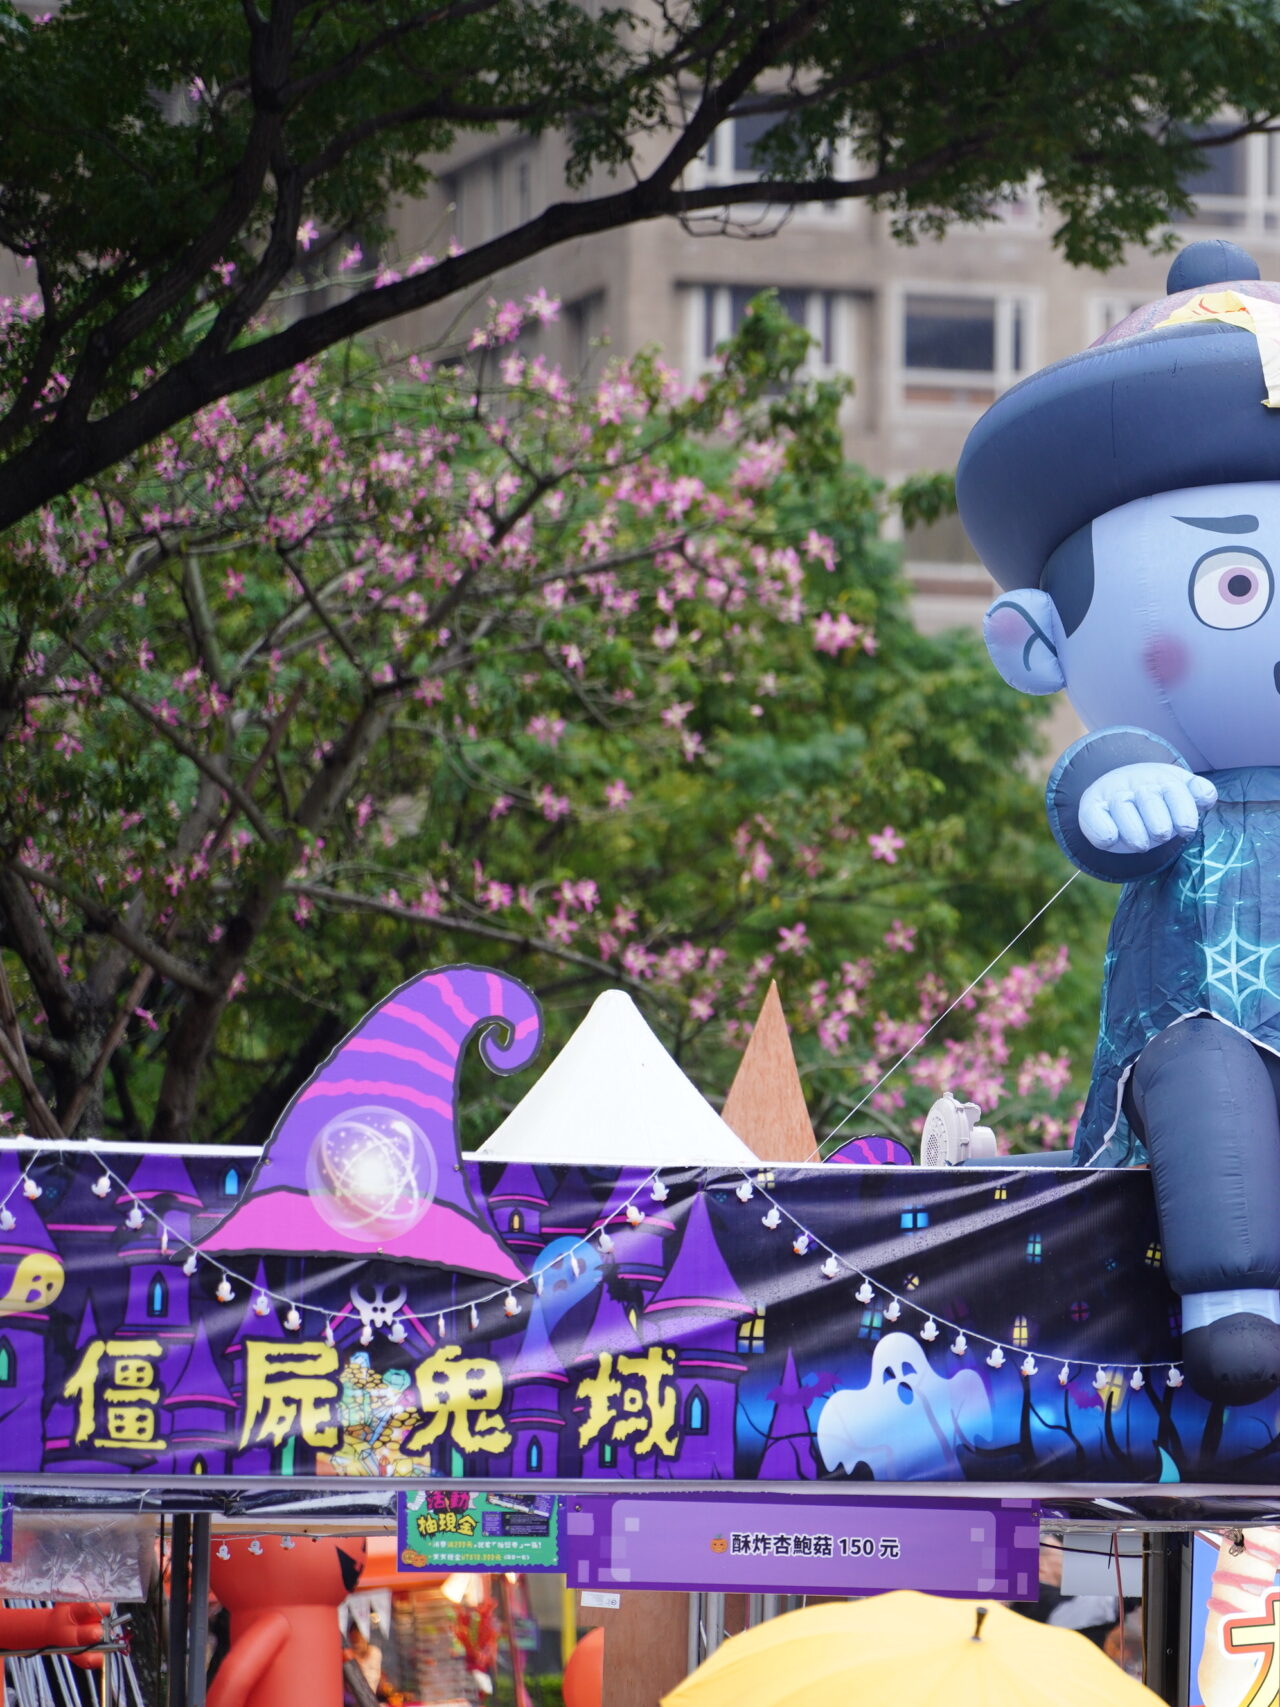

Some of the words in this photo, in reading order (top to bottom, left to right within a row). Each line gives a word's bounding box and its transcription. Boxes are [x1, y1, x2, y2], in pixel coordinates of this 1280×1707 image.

[65, 1339, 682, 1457] 僵屍鬼域
[417, 1512, 476, 1536] 抽現金
[731, 1534, 832, 1556] 酥炸杏鮑菇
[839, 1539, 874, 1556] 150
[880, 1538, 899, 1558] 元
